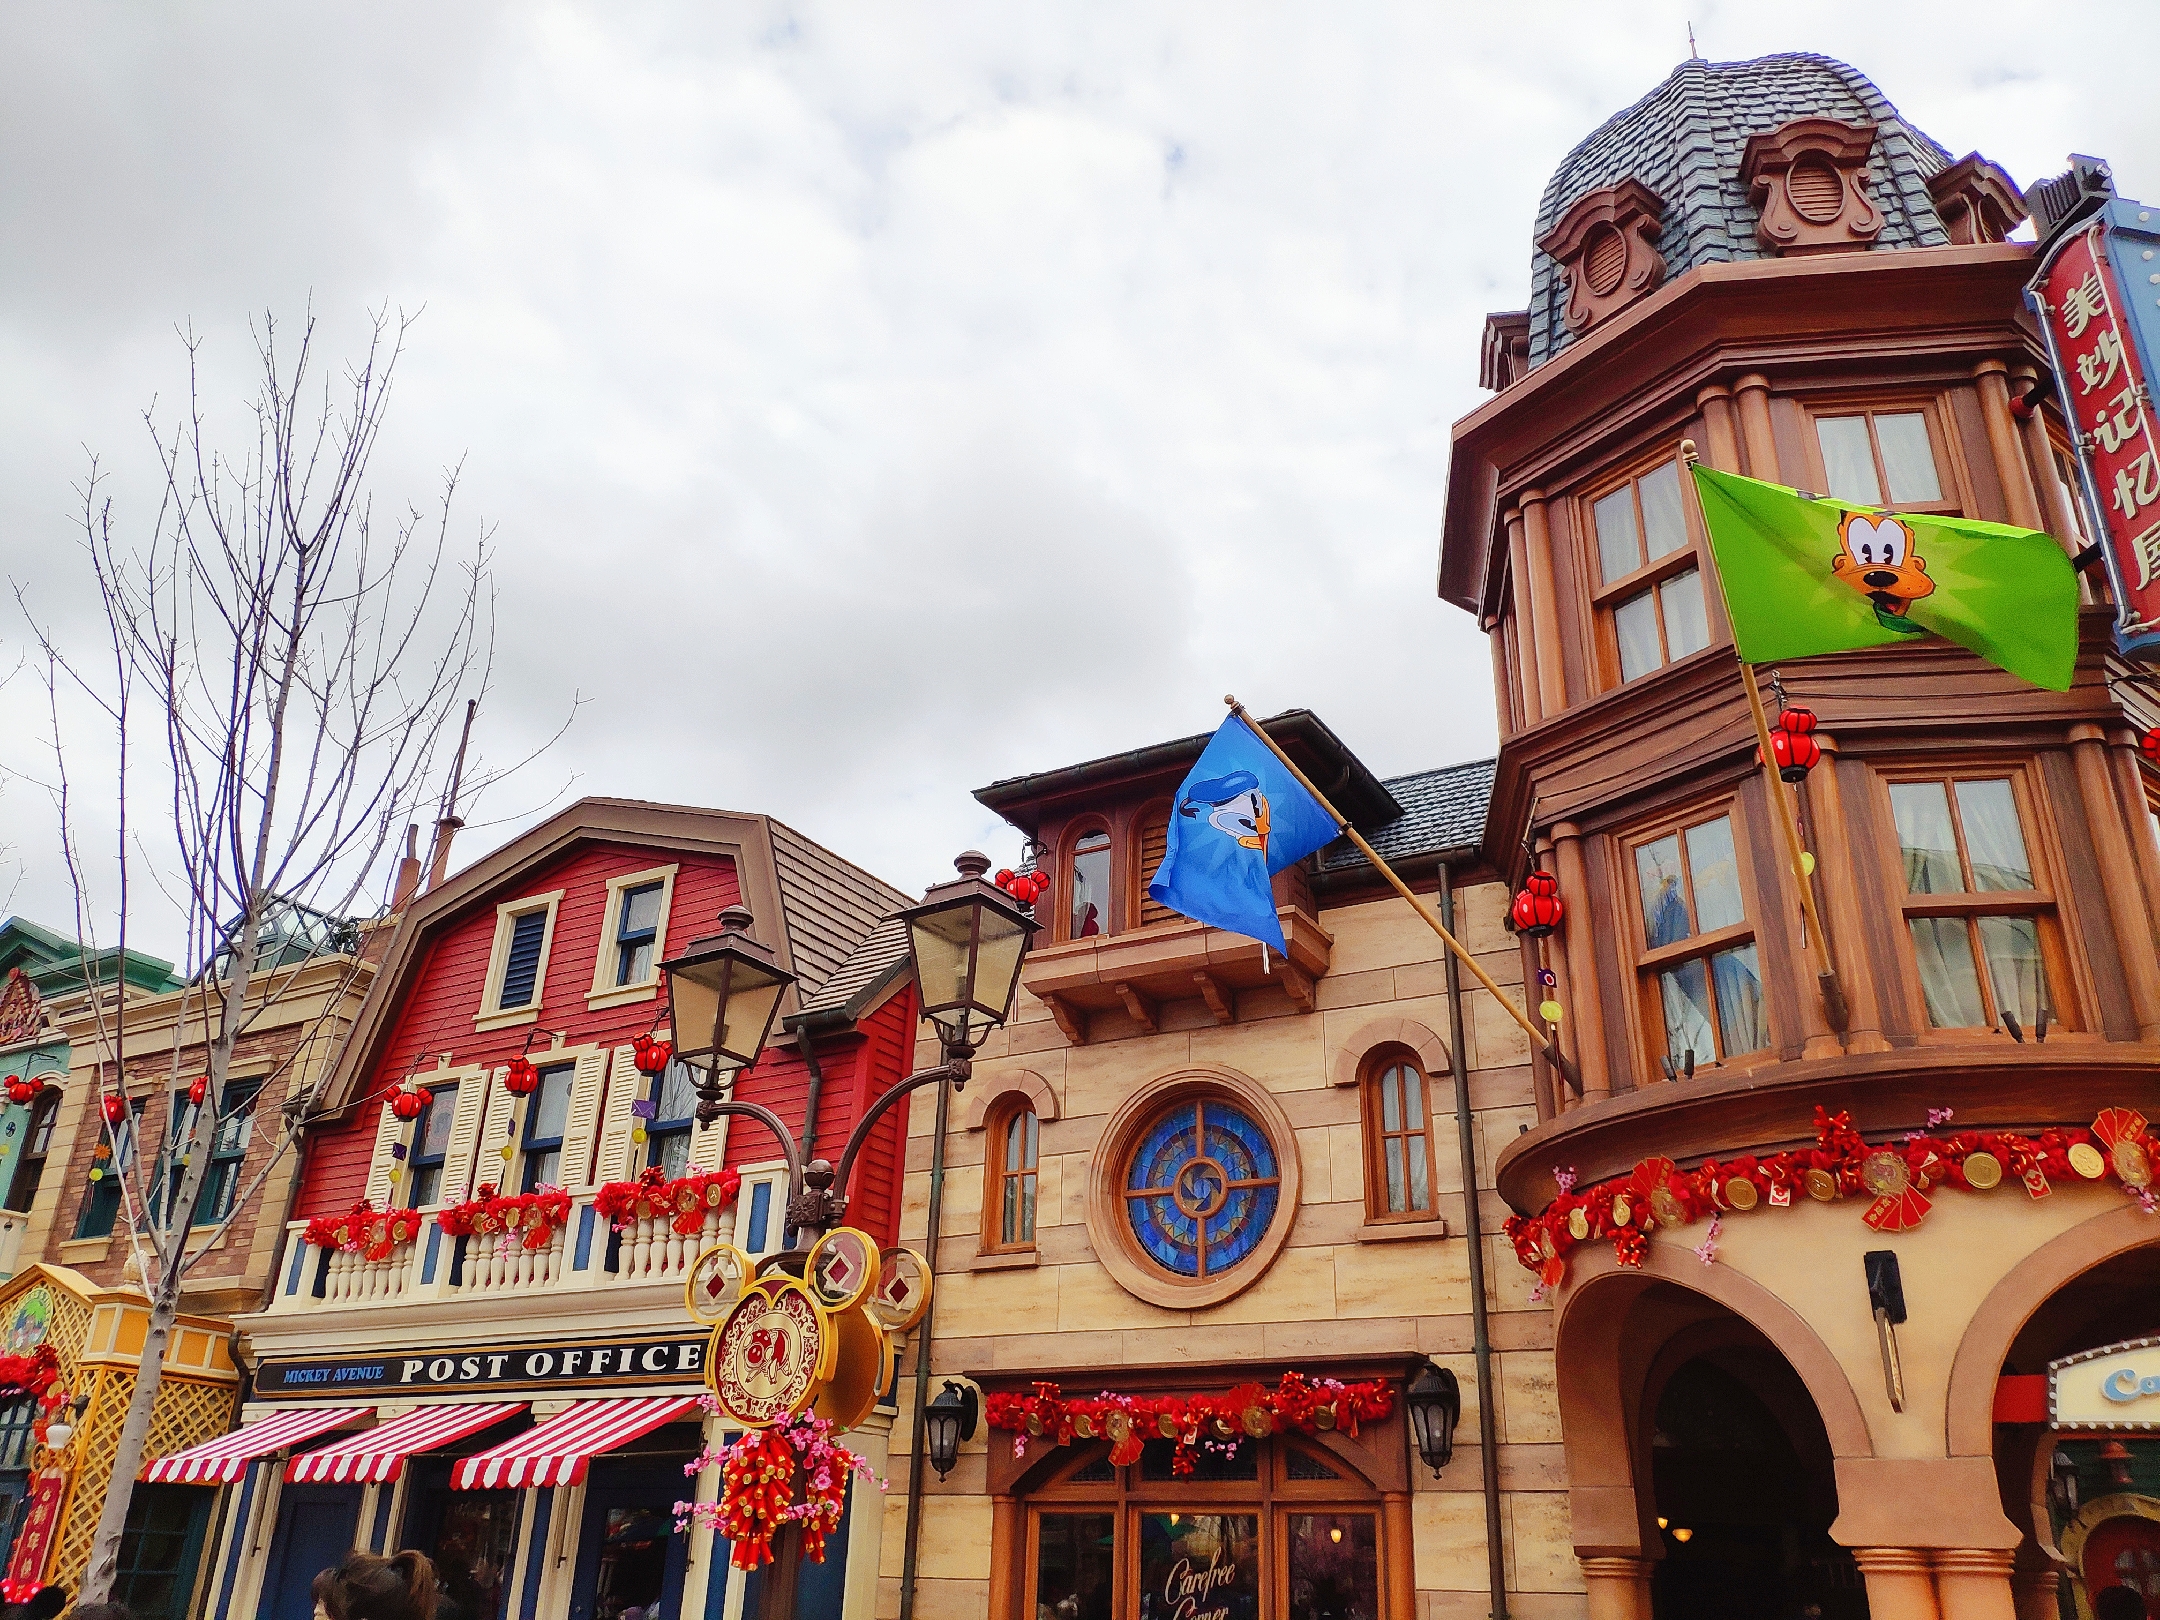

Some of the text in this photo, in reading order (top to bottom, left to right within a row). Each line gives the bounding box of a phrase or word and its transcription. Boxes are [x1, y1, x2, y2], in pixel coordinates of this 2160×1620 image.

[283, 1344, 702, 1384] MICKEY AVENUE POST OFFICE
[1165, 1546, 1236, 1605] Carefree
